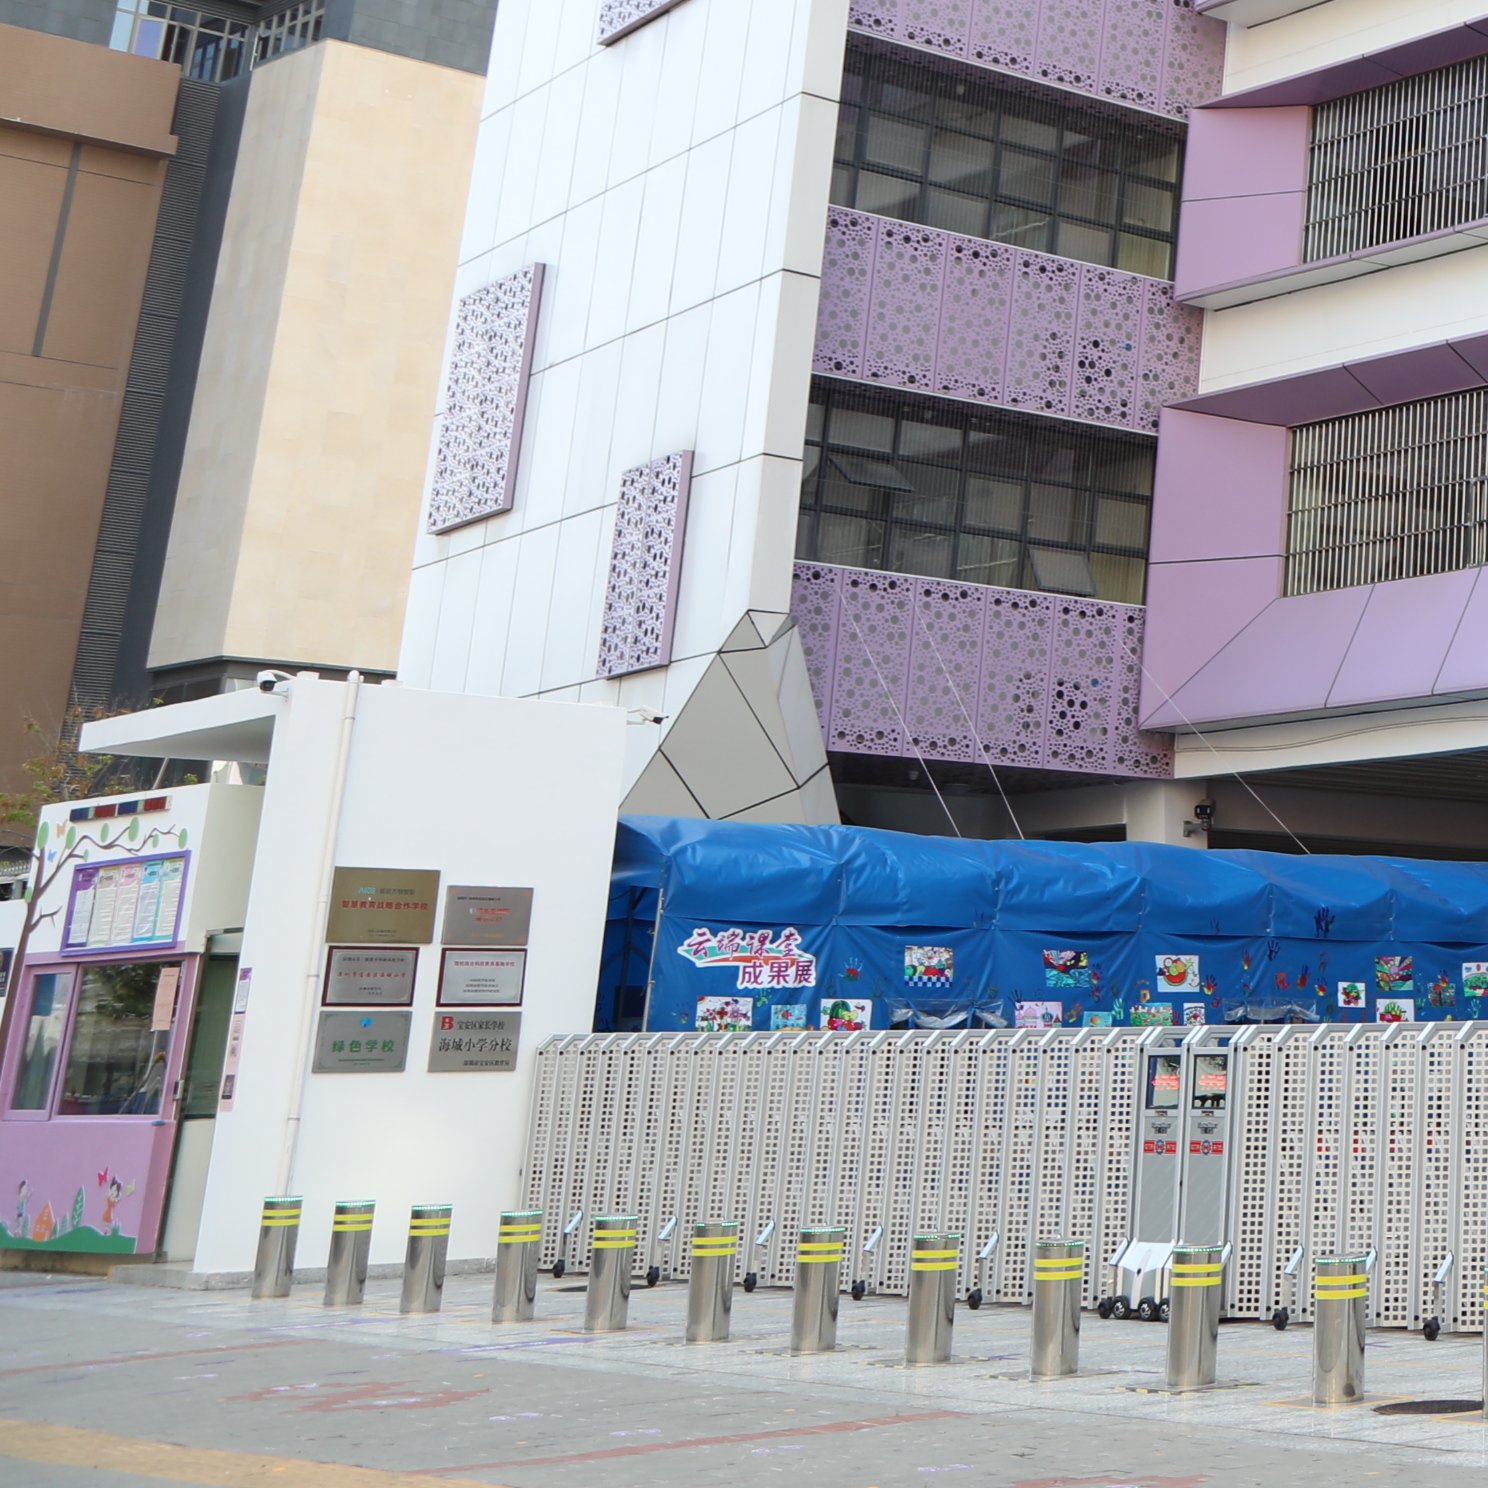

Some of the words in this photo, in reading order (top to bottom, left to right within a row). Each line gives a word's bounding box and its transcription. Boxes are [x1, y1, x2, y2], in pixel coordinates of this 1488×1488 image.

[687, 931, 799, 960] 云端课堂
[740, 960, 814, 986] 成果展
[457, 1020, 506, 1030] 宝安区家长学校
[332, 1039, 395, 1053] 绿色学校
[438, 1037, 512, 1052] 海城小学分校
